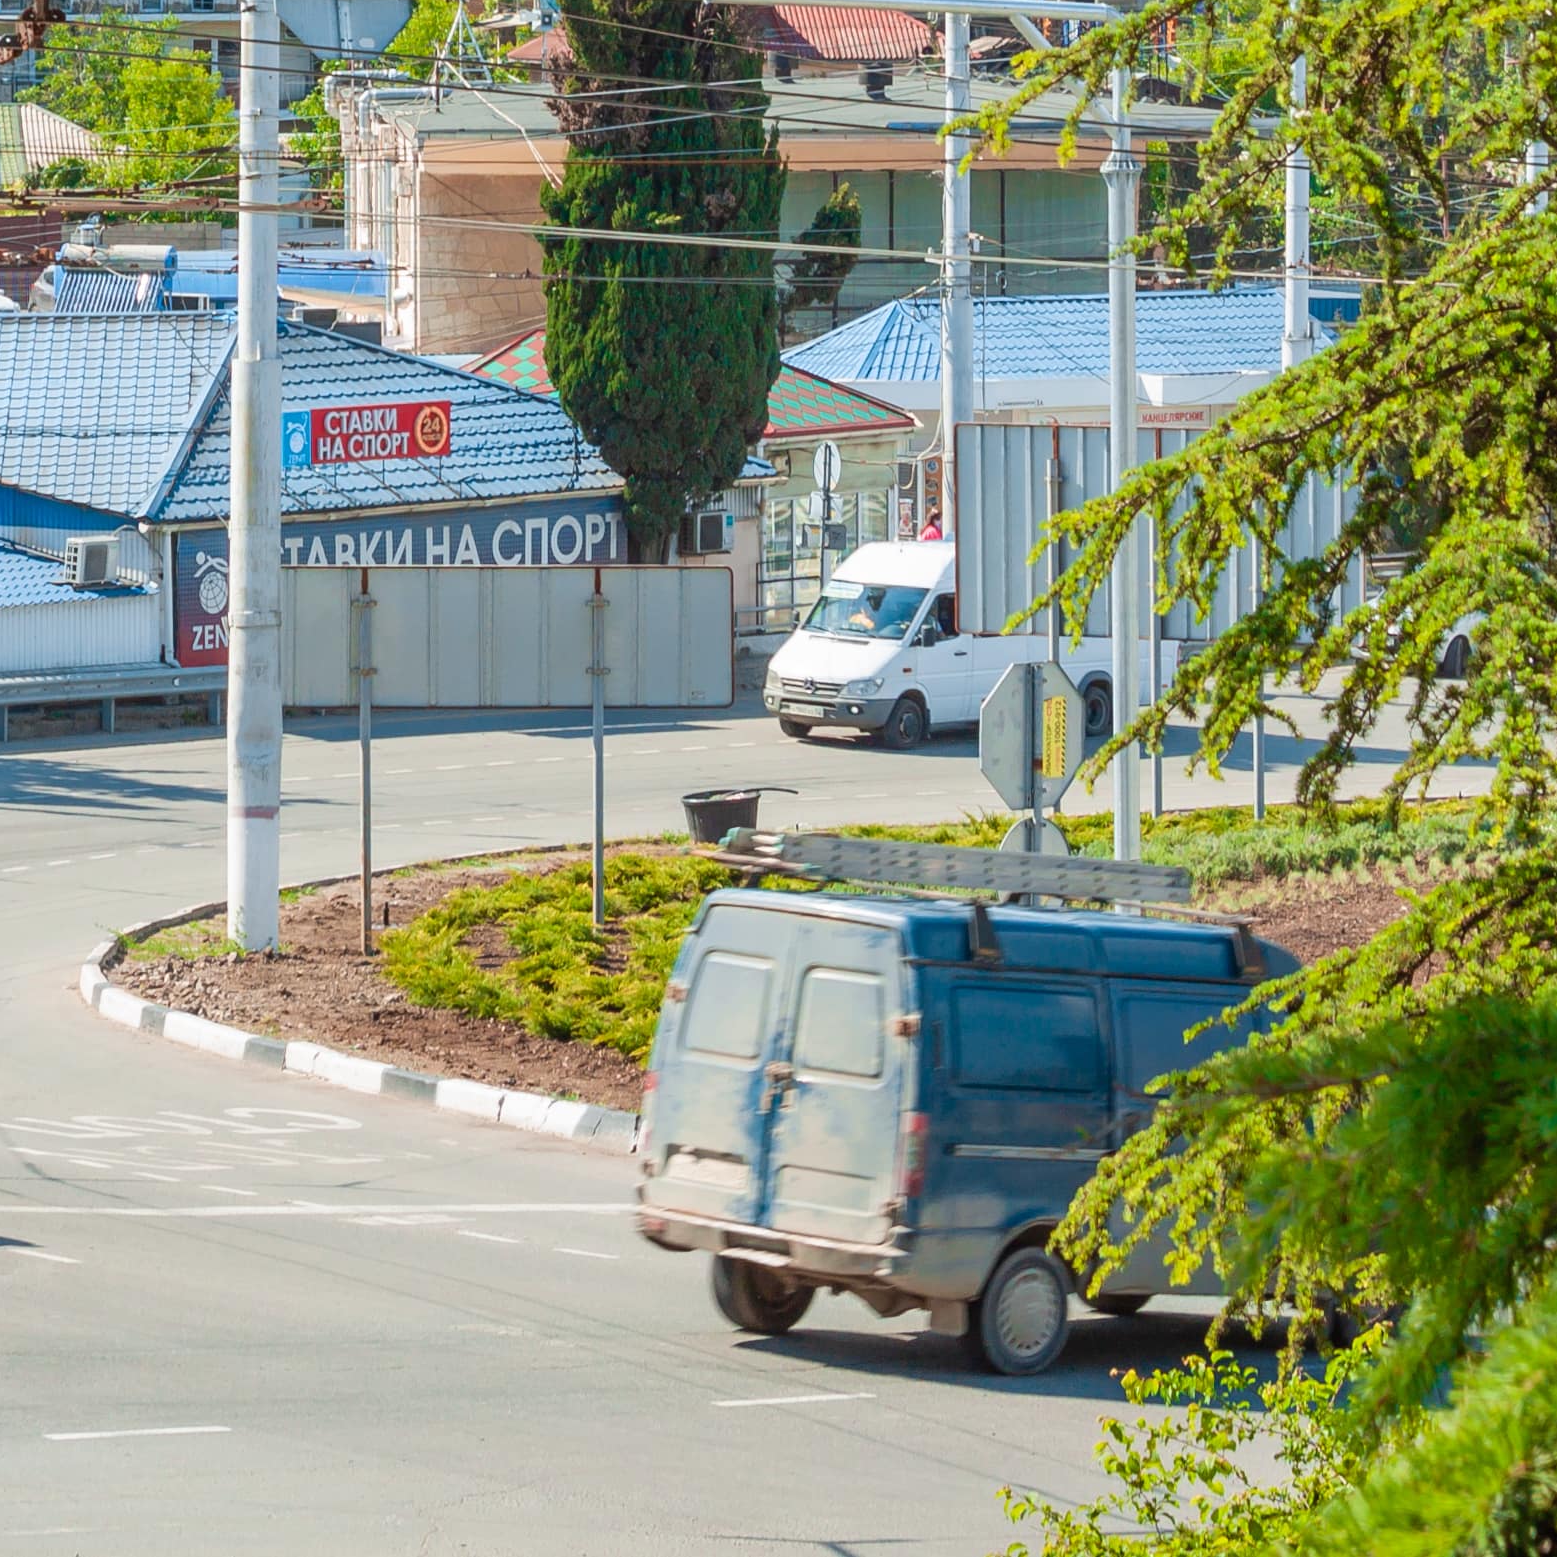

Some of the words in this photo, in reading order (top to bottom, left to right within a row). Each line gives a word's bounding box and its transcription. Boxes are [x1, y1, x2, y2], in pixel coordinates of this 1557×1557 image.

[324, 408, 398, 435] СТАВКИ
[422, 417, 440, 433] 24
[1142, 411, 1205, 423] КАНЦЕЛЯРСКИЕ
[318, 435, 345, 460] НА
[348, 432, 410, 458] СПОРТ
[280, 529, 412, 565] ТАВКИ
[426, 524, 481, 565] НА
[492, 512, 622, 565] СПОРТ
[192, 624, 229, 651] ZEN
